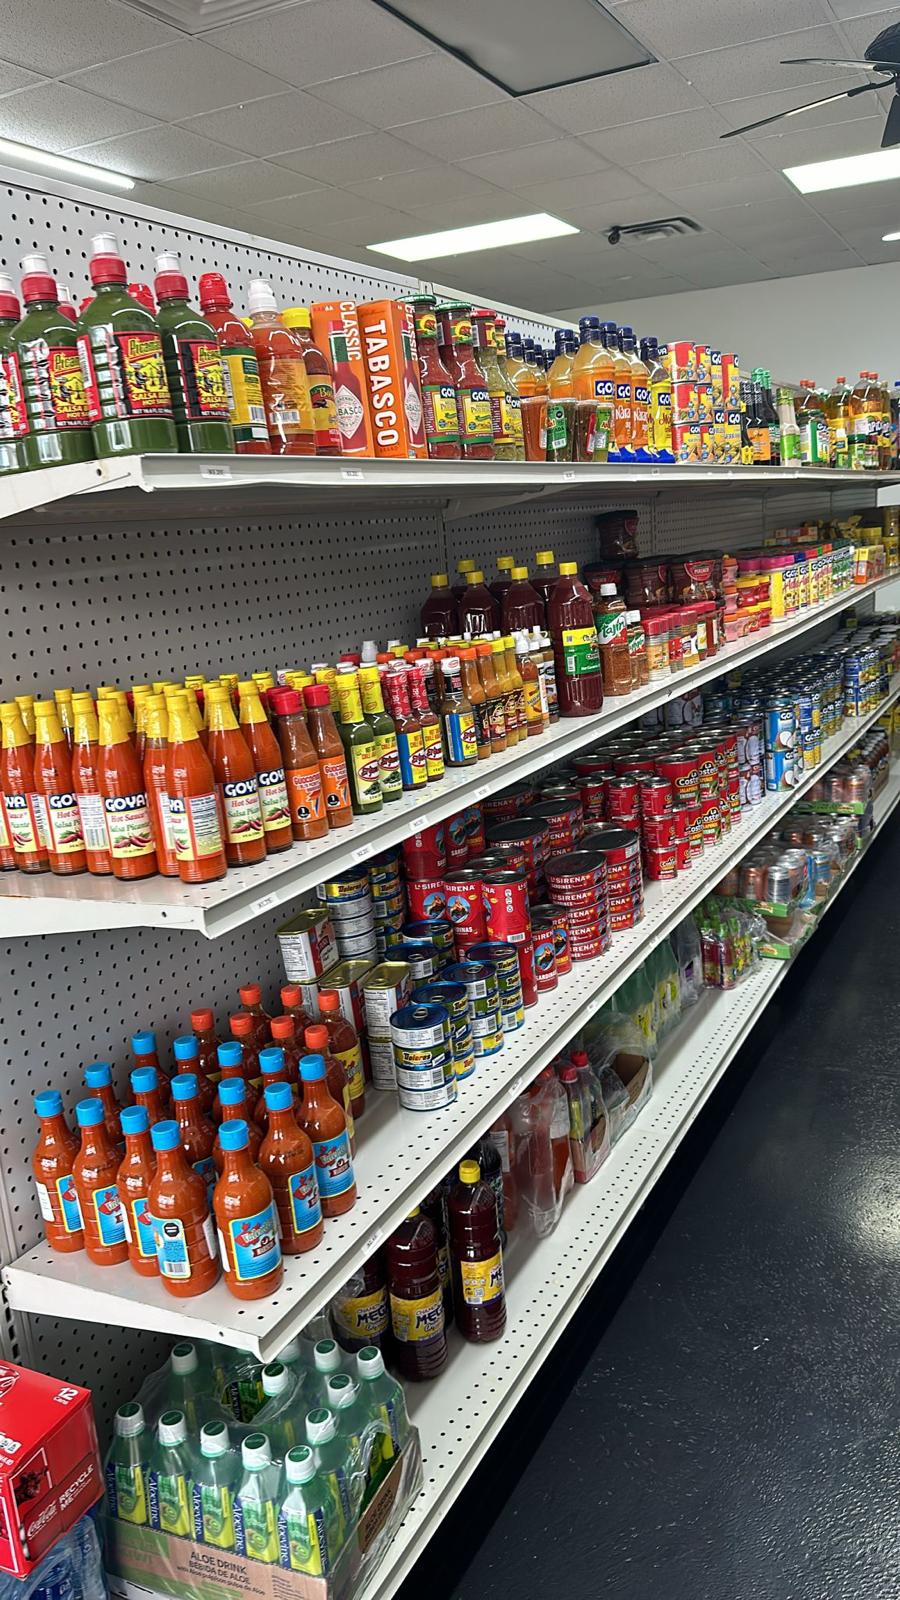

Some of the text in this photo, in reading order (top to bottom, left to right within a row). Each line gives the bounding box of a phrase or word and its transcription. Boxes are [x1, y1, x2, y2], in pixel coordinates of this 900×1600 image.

[339, 301, 362, 361] CLASSIC
[364, 320, 399, 446] TABASCO
[105, 794, 146, 812] GOYA
[555, 876, 586, 884] SIRENA
[558, 892, 588, 901] SIRENA
[403, 1053, 431, 1061] Dolores
[57, 1387, 79, 1401] 12
[59, 1463, 94, 1504] RECYCLE
[149, 1476, 160, 1523] Aloevine
[193, 1489, 203, 1536] Aloevine
[233, 1502, 245, 1553] Aloevine
[278, 1515, 289, 1562] Aloevine
[189, 1560, 251, 1585] BEBIDA DE ALOE
[190, 1551, 247, 1575] ALOE DRINK
